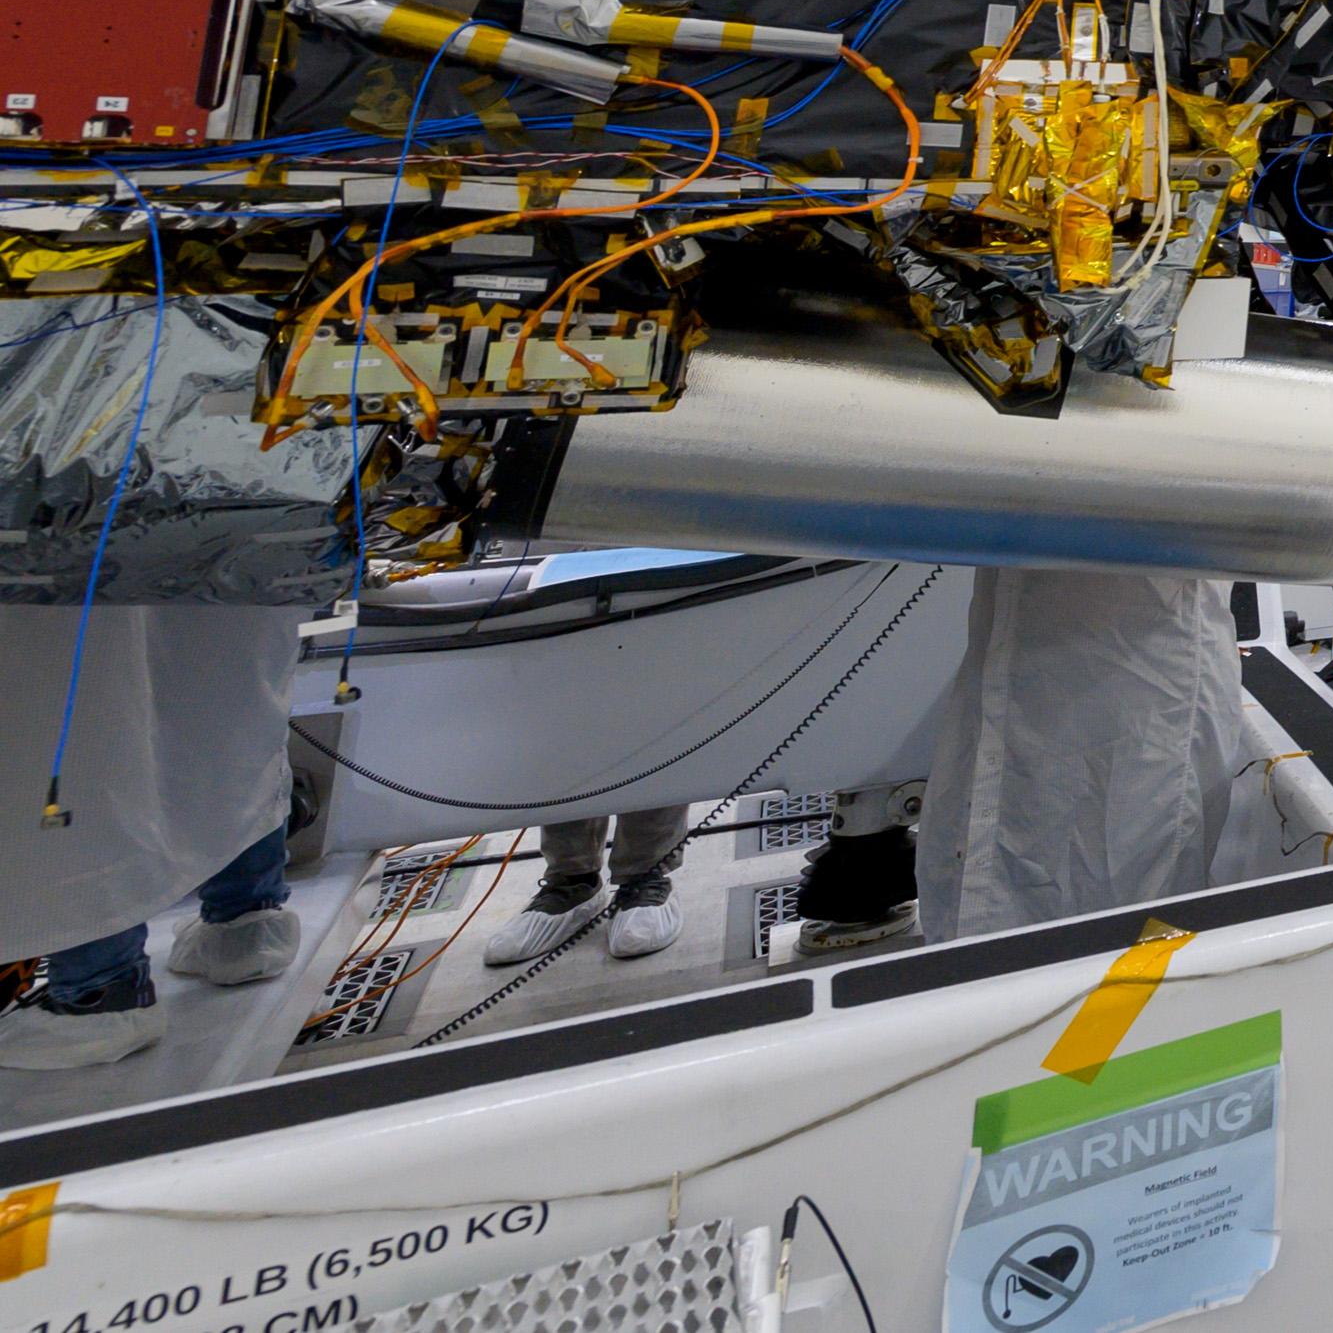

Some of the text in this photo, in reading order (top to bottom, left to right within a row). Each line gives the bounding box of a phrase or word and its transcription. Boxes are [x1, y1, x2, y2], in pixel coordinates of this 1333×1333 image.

[984, 1092, 1254, 1208] WARNING
[1145, 1165, 1217, 1195] Magnetic Field
[1114, 1194, 1243, 1243] medical devices should not
[1128, 1185, 1231, 1225] Wearers of implanted
[220, 1265, 287, 1305] LB
[307, 1224, 450, 1291] (6,500
[465, 1201, 550, 1247] KG)
[1116, 1233, 1170, 1257] participate
[1172, 1230, 1182, 1238] in
[1184, 1223, 1201, 1234] this
[1122, 1246, 1170, 1267] Keep-Out
[1173, 1237, 1197, 1251] Zone
[1209, 1227, 1220, 1237] 10
